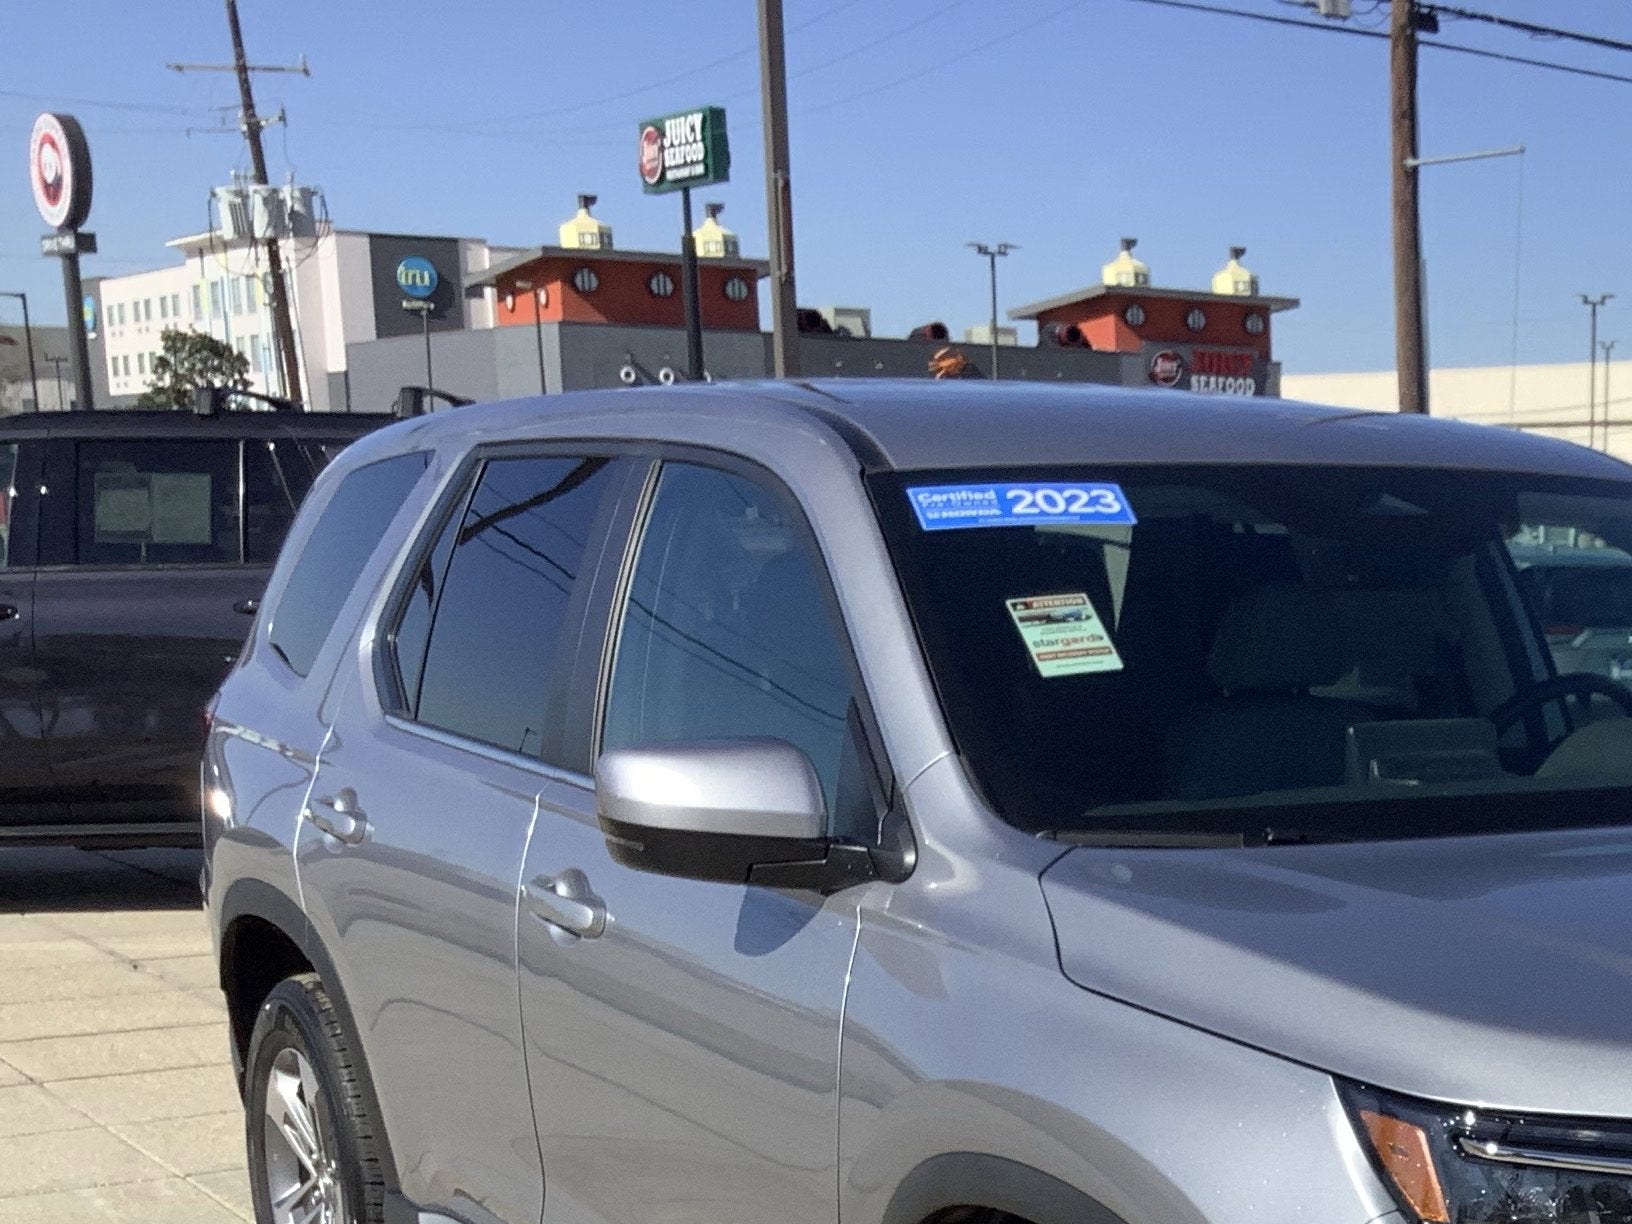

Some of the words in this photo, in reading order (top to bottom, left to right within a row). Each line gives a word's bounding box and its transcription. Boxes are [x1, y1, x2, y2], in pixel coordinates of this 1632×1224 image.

[664, 112, 703, 147] JUICY
[664, 141, 705, 168] SEAFOOD
[1190, 375, 1256, 397] SEAFOOD
[918, 488, 996, 503] Certified
[1006, 489, 1122, 514] 2023
